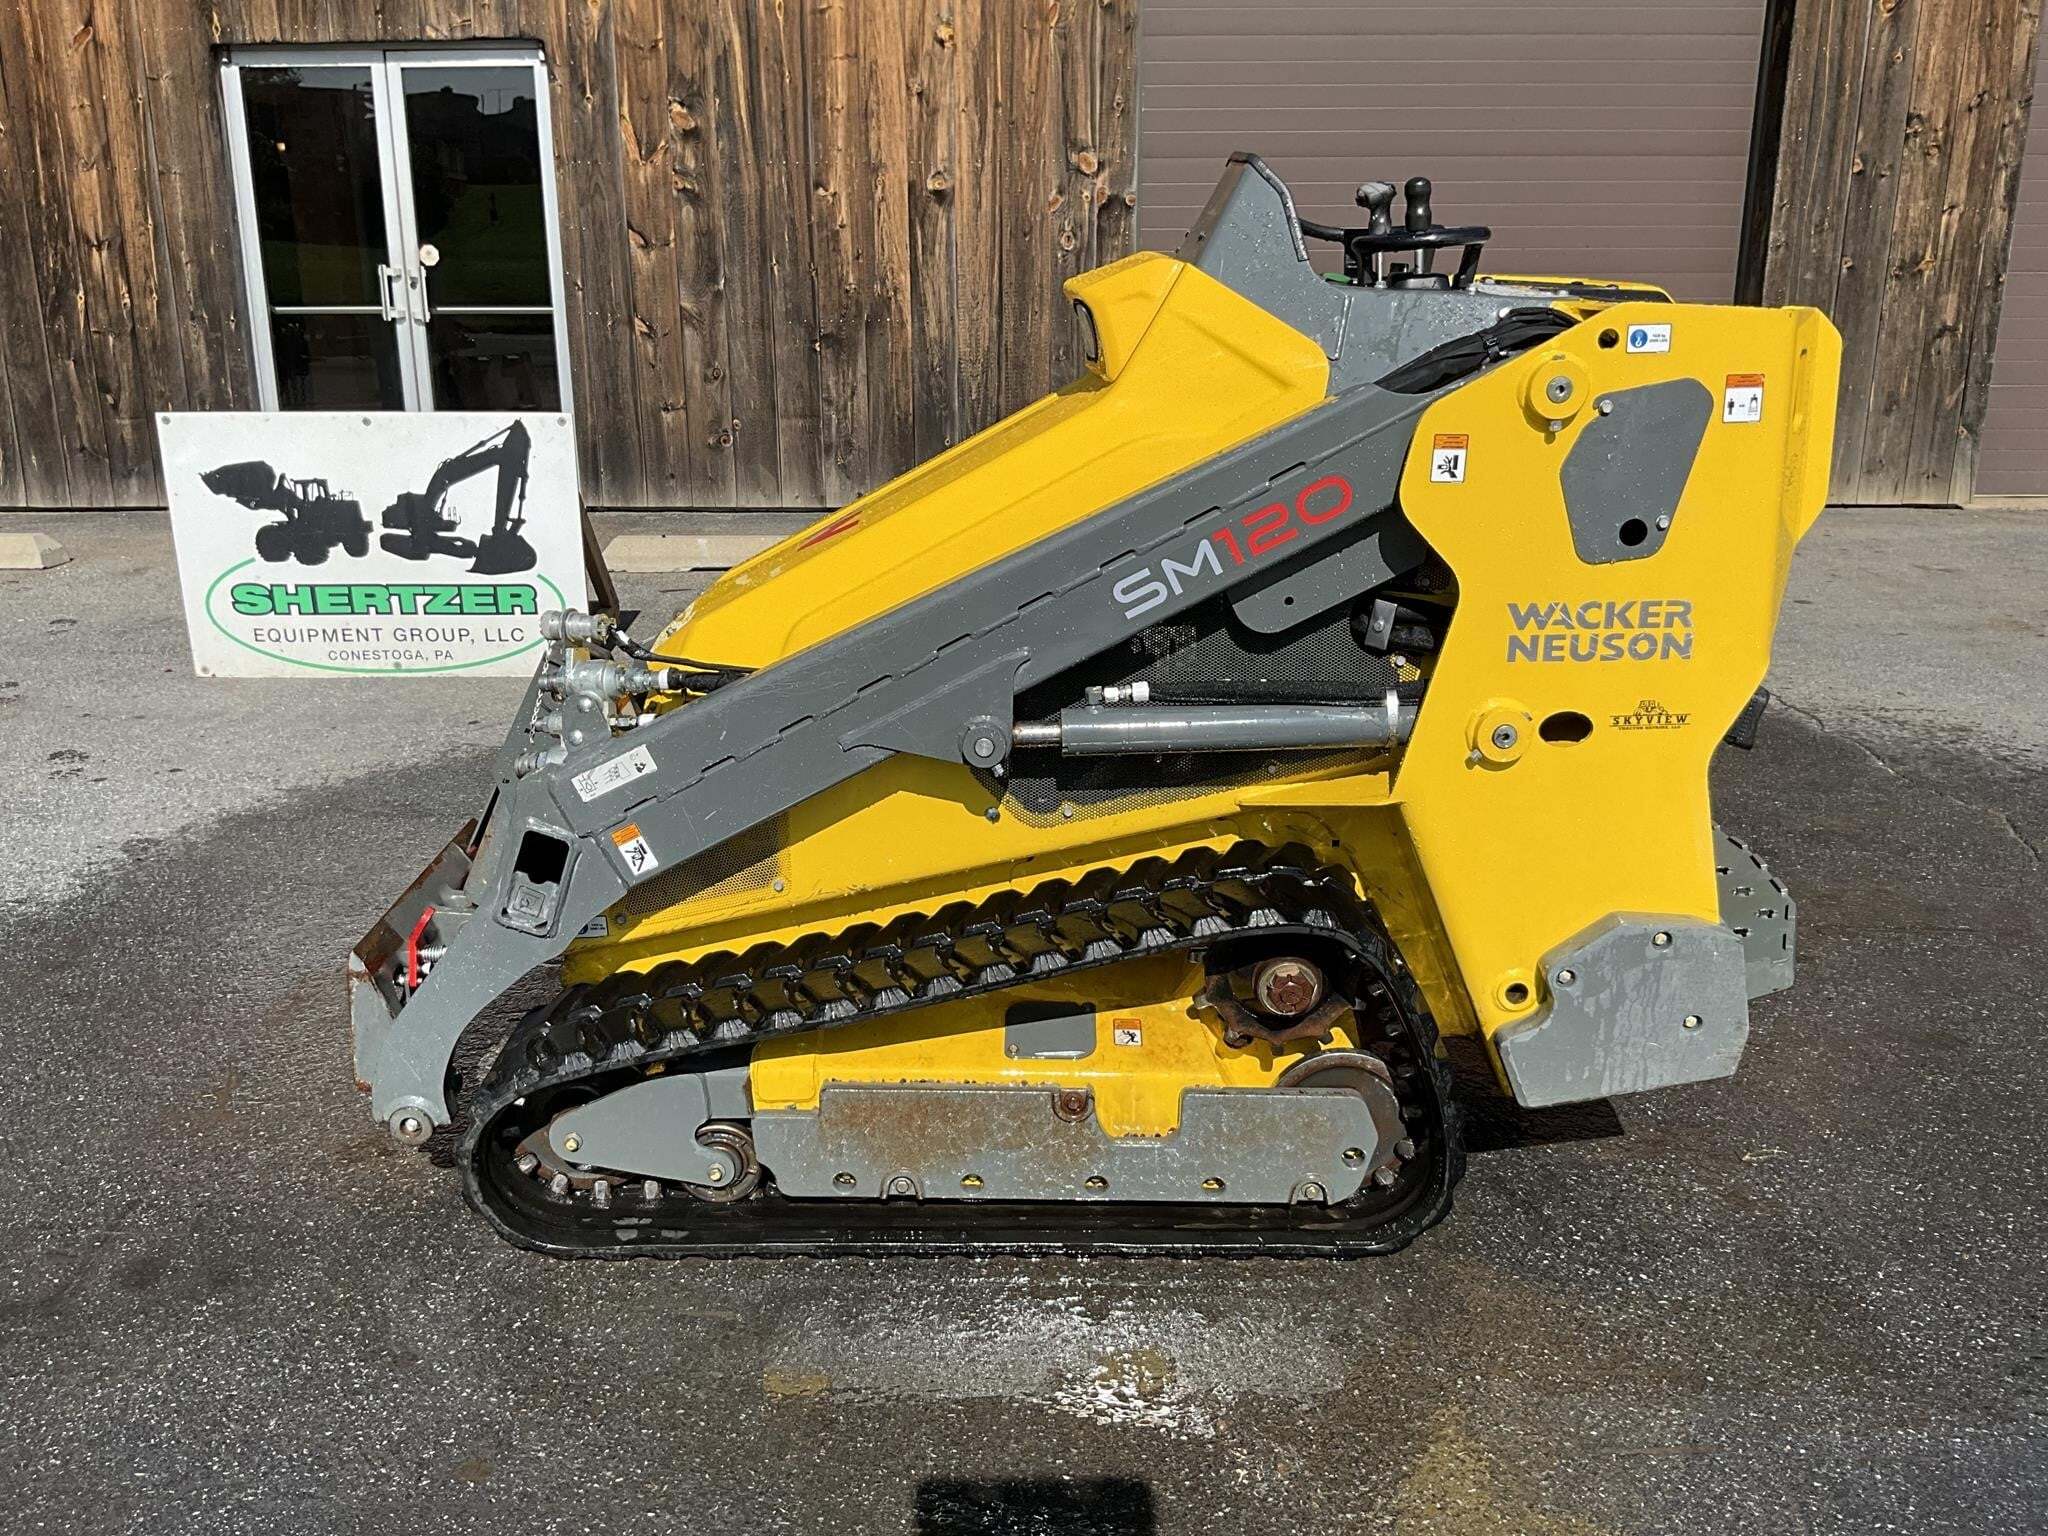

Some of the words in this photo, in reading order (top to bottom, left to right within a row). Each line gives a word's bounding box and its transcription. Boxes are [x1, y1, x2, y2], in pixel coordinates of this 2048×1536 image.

[1113, 475, 1352, 619] SM120
[231, 583, 538, 615] SHERTZER
[1507, 600, 1694, 631] WACKER
[253, 628, 383, 643] EQUIPMENT
[393, 628, 475, 645] GROUP,
[484, 628, 525, 642] LLC
[1506, 633, 1694, 663] NEUSON
[328, 650, 429, 662] CONESTOGA,
[435, 650, 454, 660] PA
[1612, 715, 1688, 725] SKYVIEW
